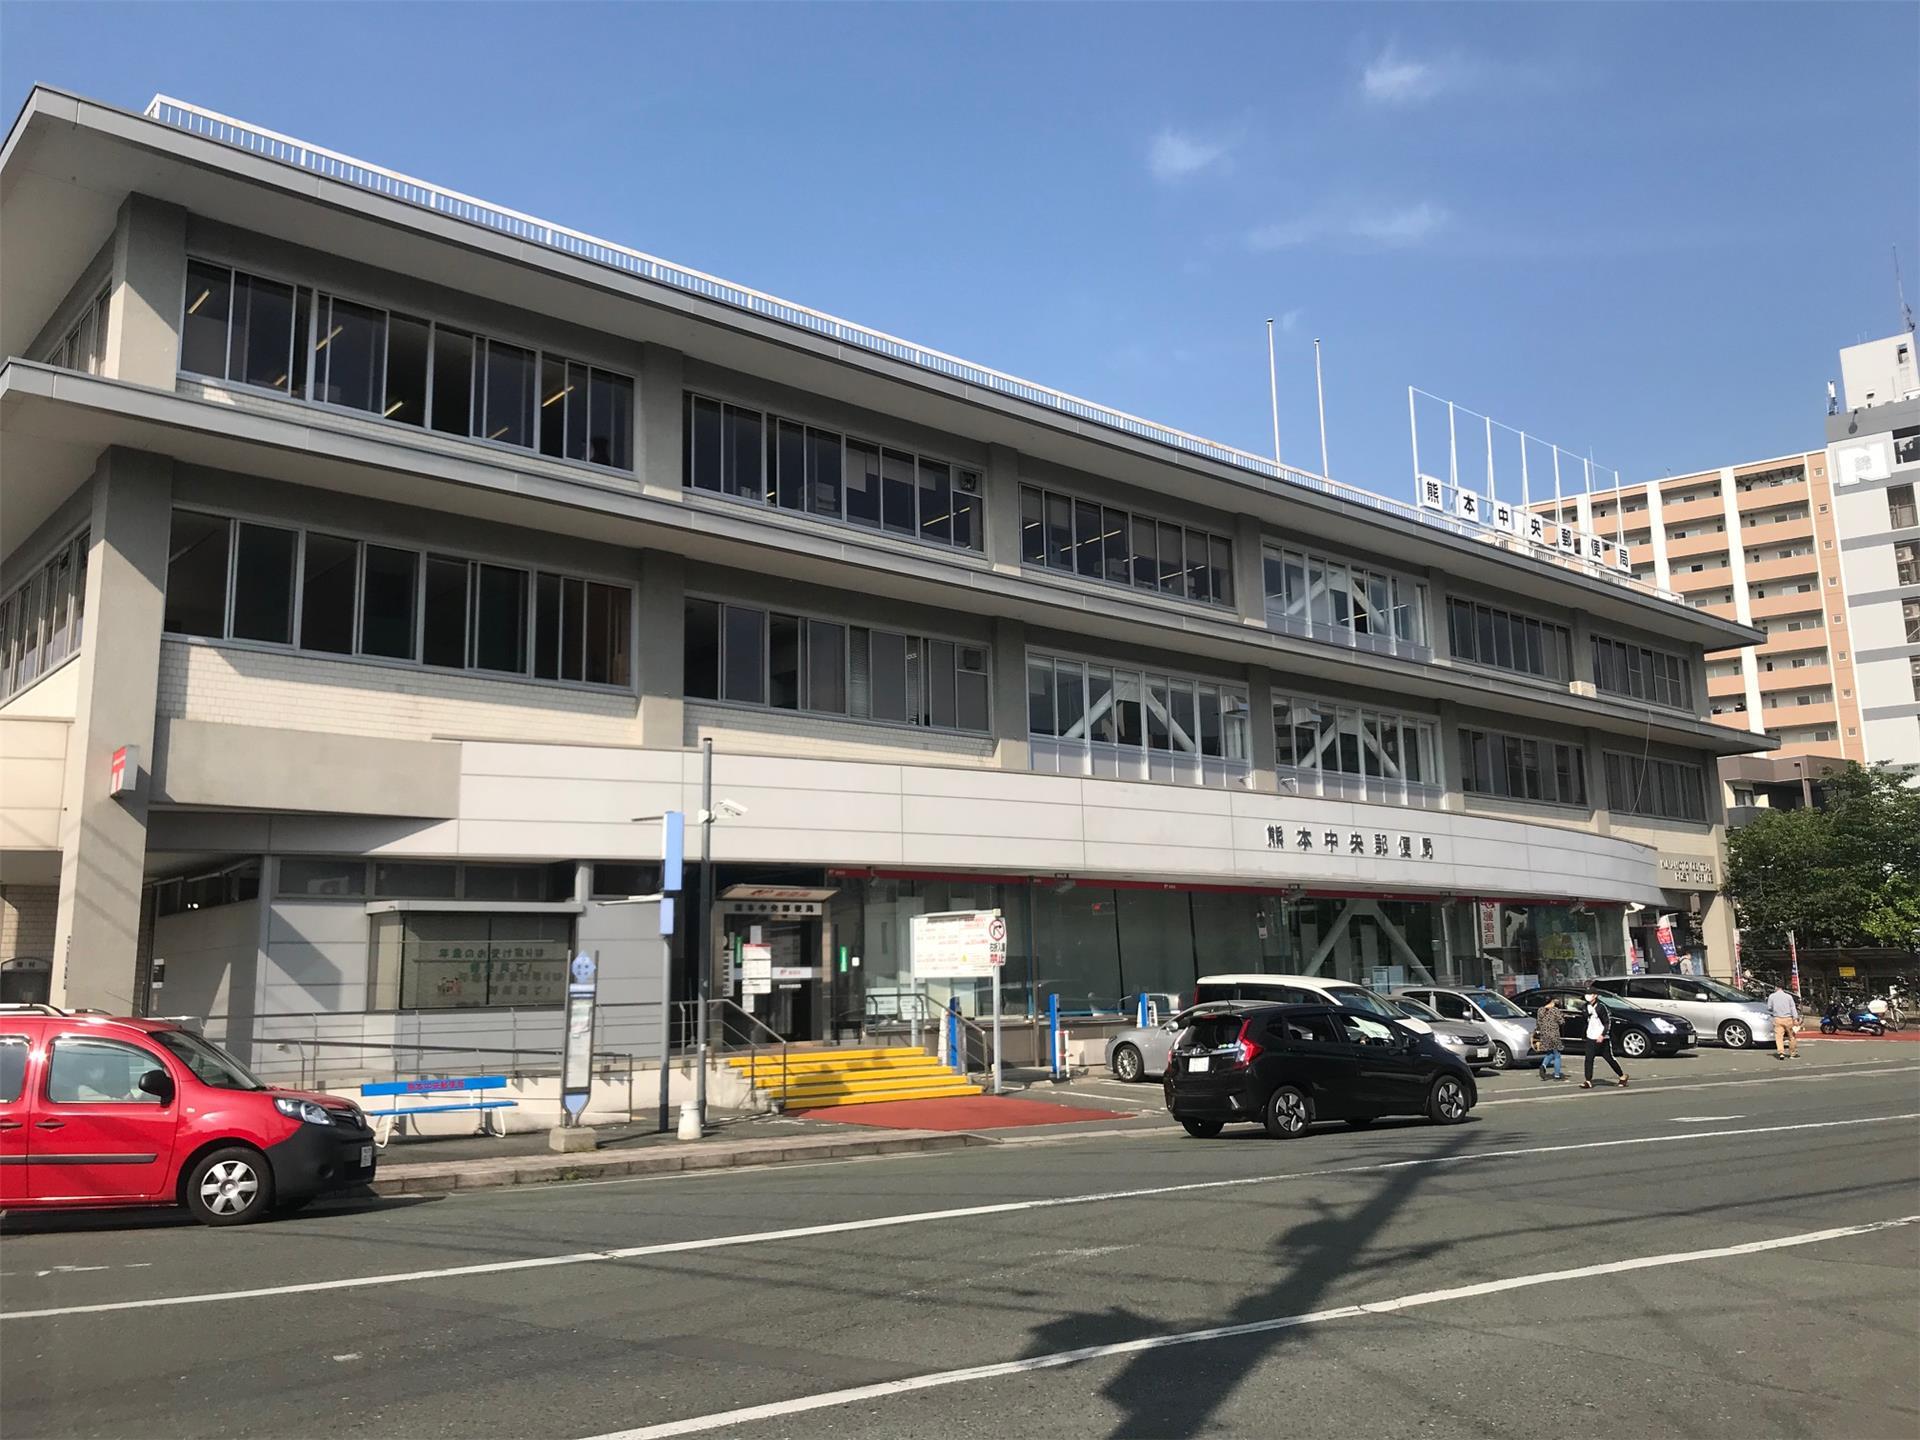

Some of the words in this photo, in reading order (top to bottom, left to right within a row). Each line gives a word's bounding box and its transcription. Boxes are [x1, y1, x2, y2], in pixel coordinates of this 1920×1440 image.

[1425, 480, 1630, 570] 熊本中央郵便局
[1265, 824, 1434, 860] 熊本中央郵便局
